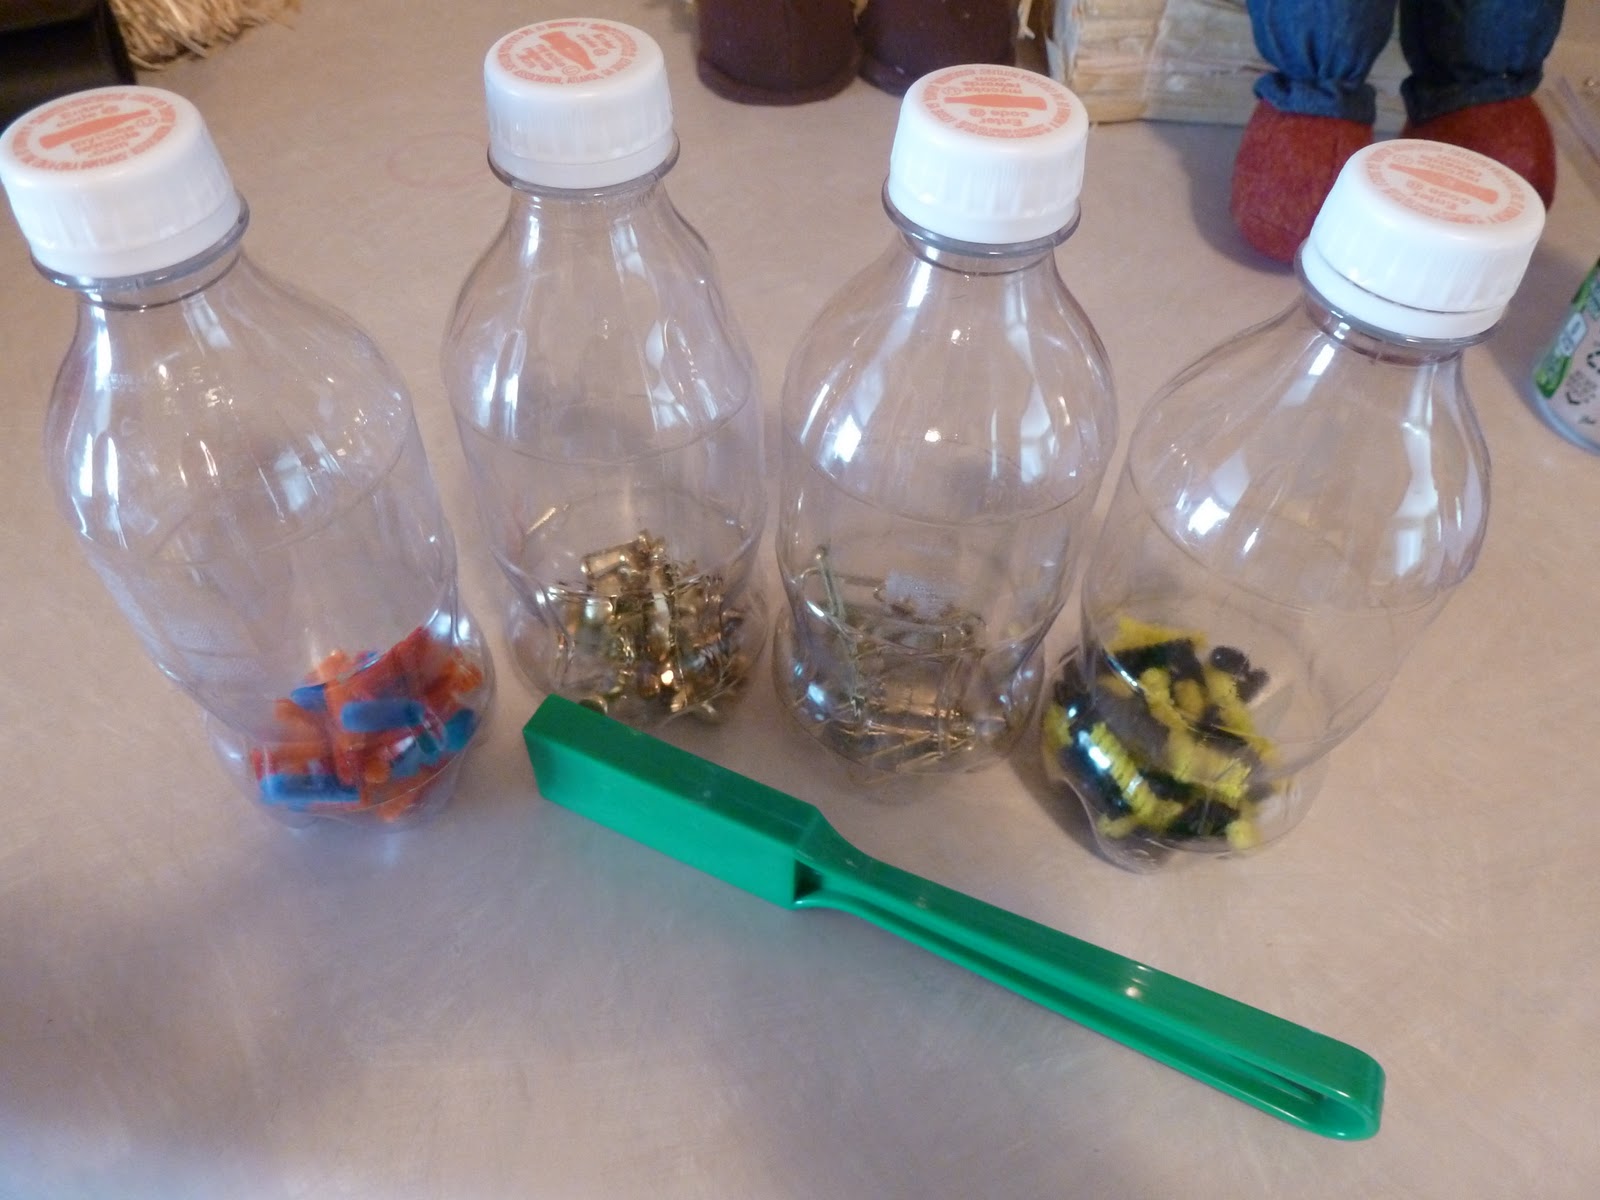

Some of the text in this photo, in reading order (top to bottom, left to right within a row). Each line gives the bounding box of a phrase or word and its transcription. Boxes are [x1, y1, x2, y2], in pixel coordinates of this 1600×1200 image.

[963, 86, 1023, 94] mycoke
[989, 109, 1030, 118] code
[979, 118, 1023, 126] Enter
